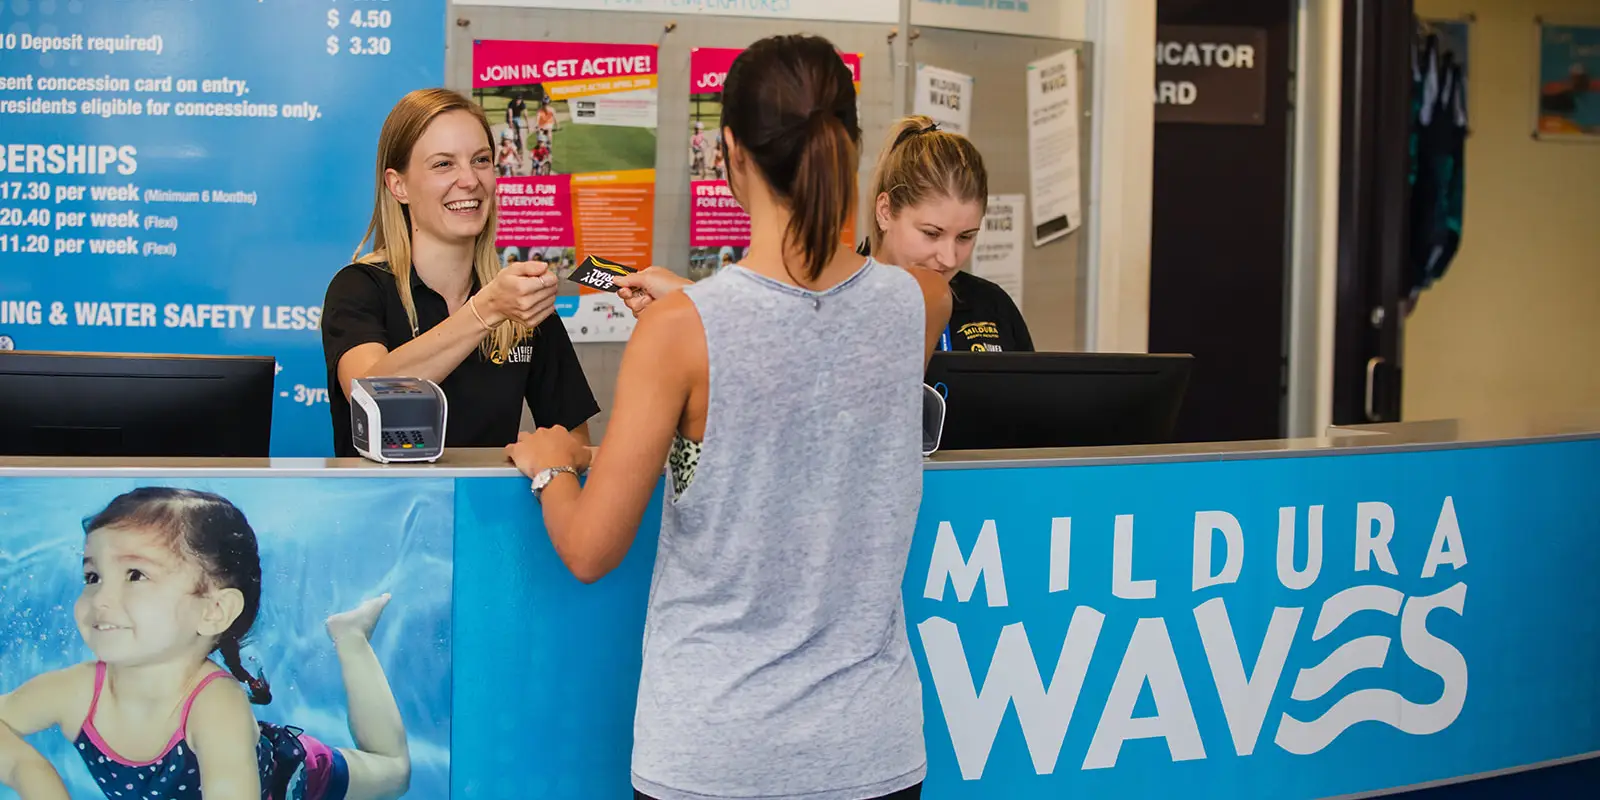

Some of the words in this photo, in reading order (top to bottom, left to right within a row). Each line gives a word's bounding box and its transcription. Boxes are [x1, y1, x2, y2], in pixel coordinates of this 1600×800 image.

[327, 8, 340, 29] $
[350, 10, 392, 28] 4.50
[21, 34, 83, 53] Deposit
[88, 35, 163, 54] required)
[326, 35, 340, 55] $
[349, 37, 391, 55] 3.30
[480, 64, 519, 82] JOIN
[542, 58, 578, 79] GET
[580, 55, 652, 76] ACTIVE!
[37, 75, 130, 92] concession
[134, 76, 172, 92] card
[176, 79, 197, 92] on
[202, 77, 249, 96] entry.
[1155, 81, 1197, 105] RD
[1, 98, 77, 114] residents
[81, 98, 142, 118] eligible
[147, 99, 169, 115] for
[175, 101, 278, 118] concessions
[282, 102, 322, 121] only.
[0, 182, 50, 200] 17.30
[55, 184, 86, 204] per
[91, 184, 140, 201] week
[144, 188, 199, 204] (Minimum
[202, 190, 210, 203] 6
[212, 190, 257, 205] Months)
[535, 183, 557, 195] FUN
[502, 195, 555, 208] EVERYONE
[696, 197, 717, 208] FOR
[0, 208, 50, 227] 20.40
[55, 210, 86, 230] per
[91, 210, 140, 228] week
[144, 215, 178, 231] (Flexi)
[0, 234, 49, 253] 11.20
[54, 237, 85, 257] per
[90, 236, 138, 254] week
[142, 242, 177, 258] (Flexi)
[591, 268, 615, 284] RIAL
[1, 300, 42, 324] ING
[49, 302, 67, 326] &
[75, 302, 157, 327] WATER
[164, 304, 256, 329] SAFETY
[262, 306, 321, 330] LESS
[923, 496, 1467, 608] MILDURA
[917, 581, 1468, 780] WAVES
